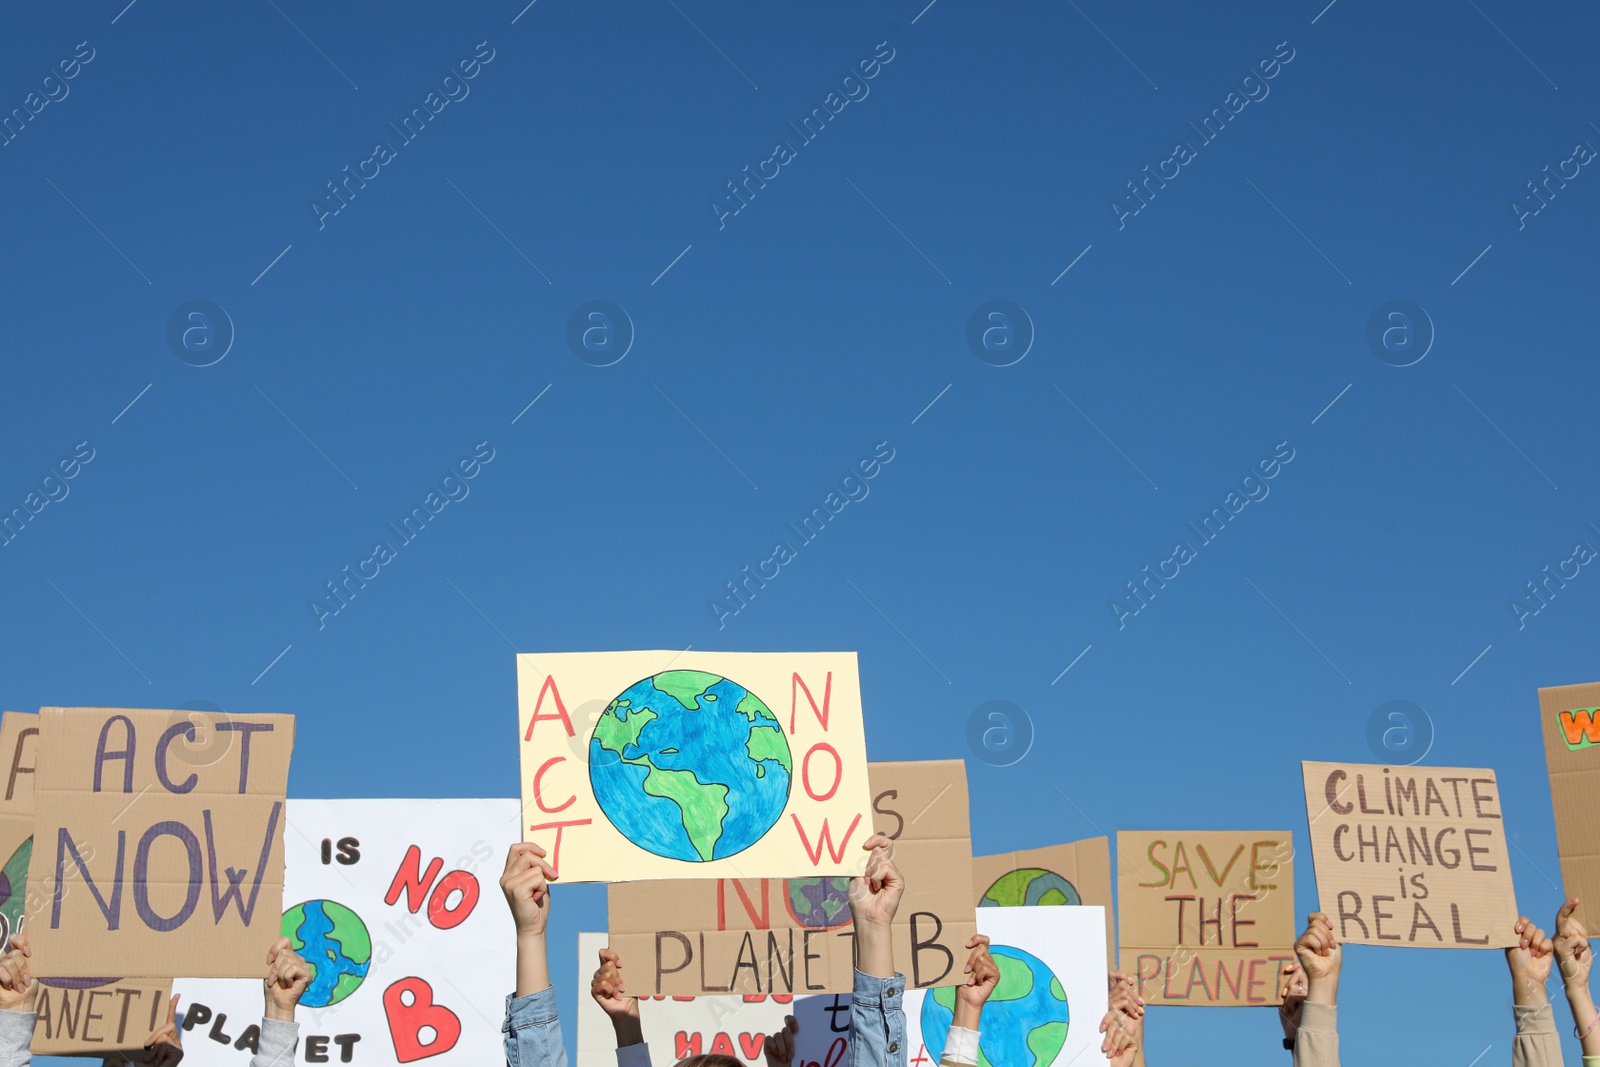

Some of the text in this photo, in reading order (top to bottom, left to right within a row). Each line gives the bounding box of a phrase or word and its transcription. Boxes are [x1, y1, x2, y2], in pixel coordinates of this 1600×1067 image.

[93, 715, 274, 794] ACT
[524, 674, 592, 878] ACT
[790, 671, 862, 867] NOW
[50, 801, 282, 932] NOW
[321, 836, 480, 931] IS NO
[1139, 840, 1278, 890] SAVE
[1333, 824, 1497, 872] CHANGE
[910, 911, 954, 989] B
[1164, 894, 1259, 948] THE
[1337, 890, 1489, 945] REAL
[1137, 954, 1294, 1004] PLANET
[182, 976, 461, 1063] PLAET B
[675, 1031, 766, 1060] HAV
